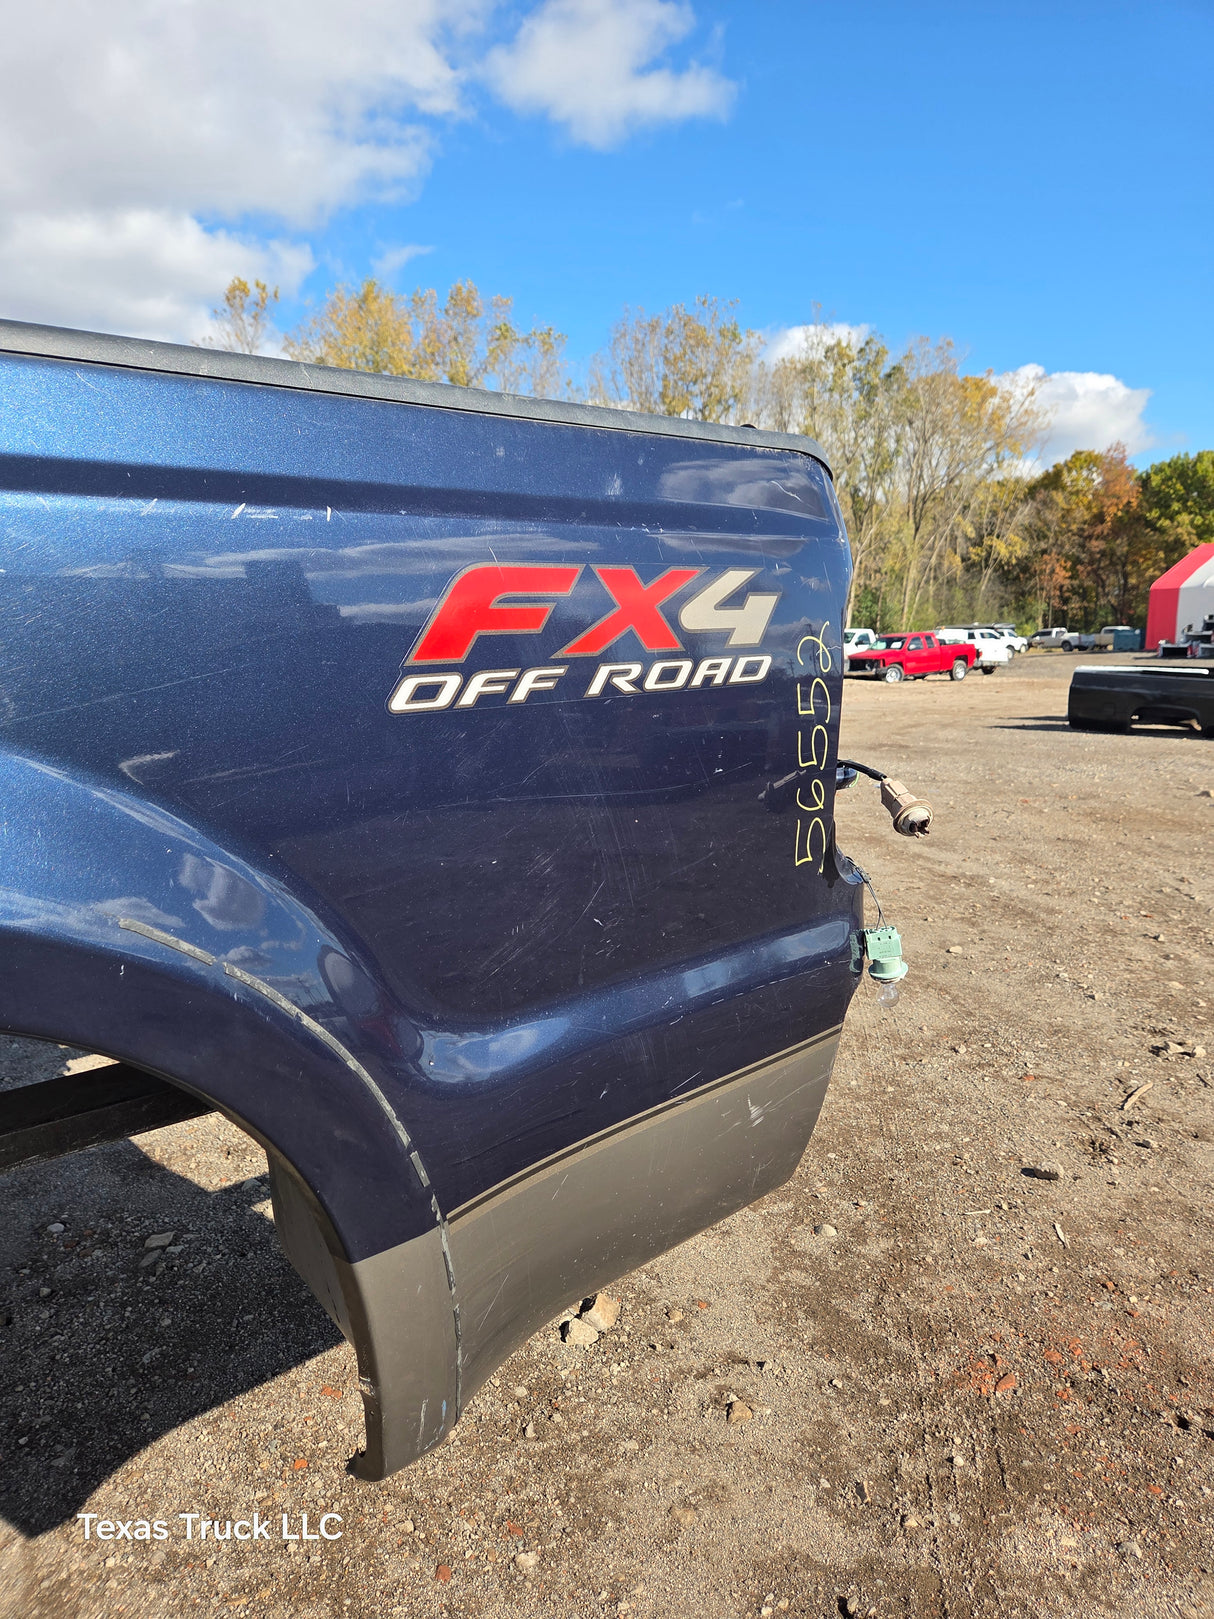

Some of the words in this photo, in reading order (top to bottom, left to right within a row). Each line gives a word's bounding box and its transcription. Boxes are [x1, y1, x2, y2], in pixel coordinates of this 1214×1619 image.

[405, 563, 782, 665] FX4
[388, 665, 569, 714] OFF
[585, 655, 772, 698] ROAD
[795, 621, 831, 873] 56552
